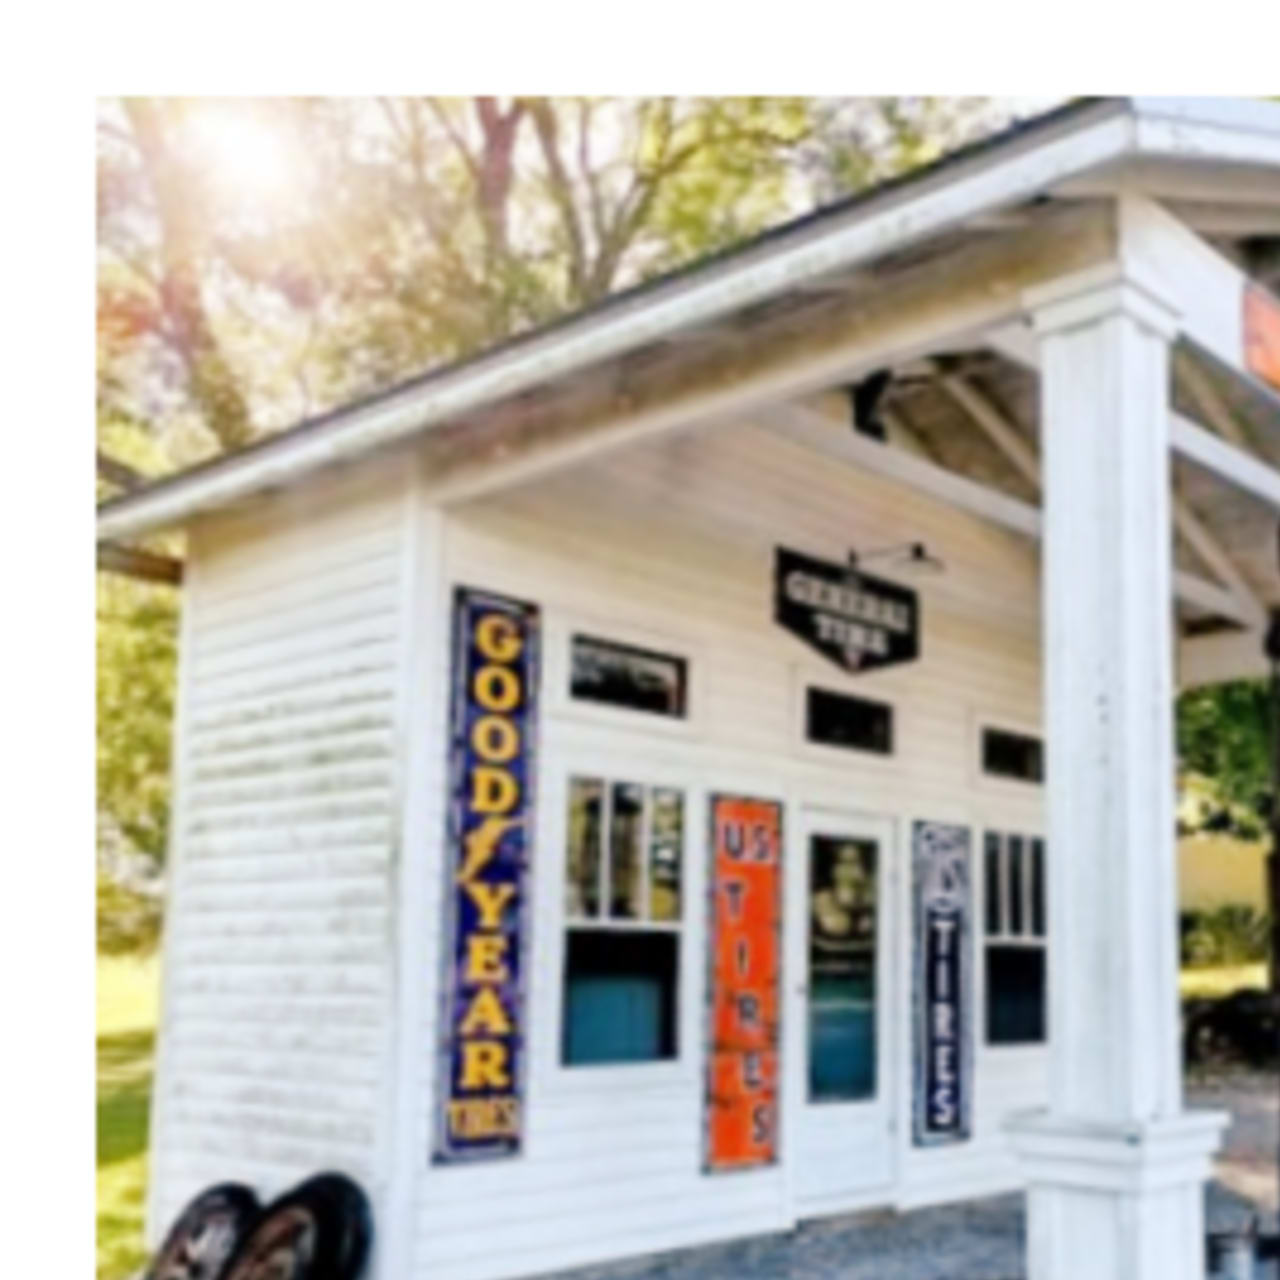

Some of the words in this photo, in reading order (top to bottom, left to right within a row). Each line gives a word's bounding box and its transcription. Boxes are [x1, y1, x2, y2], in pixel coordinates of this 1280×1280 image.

[785, 570, 909, 634] GENERAL
[724, 880, 773, 1146] TIRES
[932, 919, 956, 1126] TIRES
